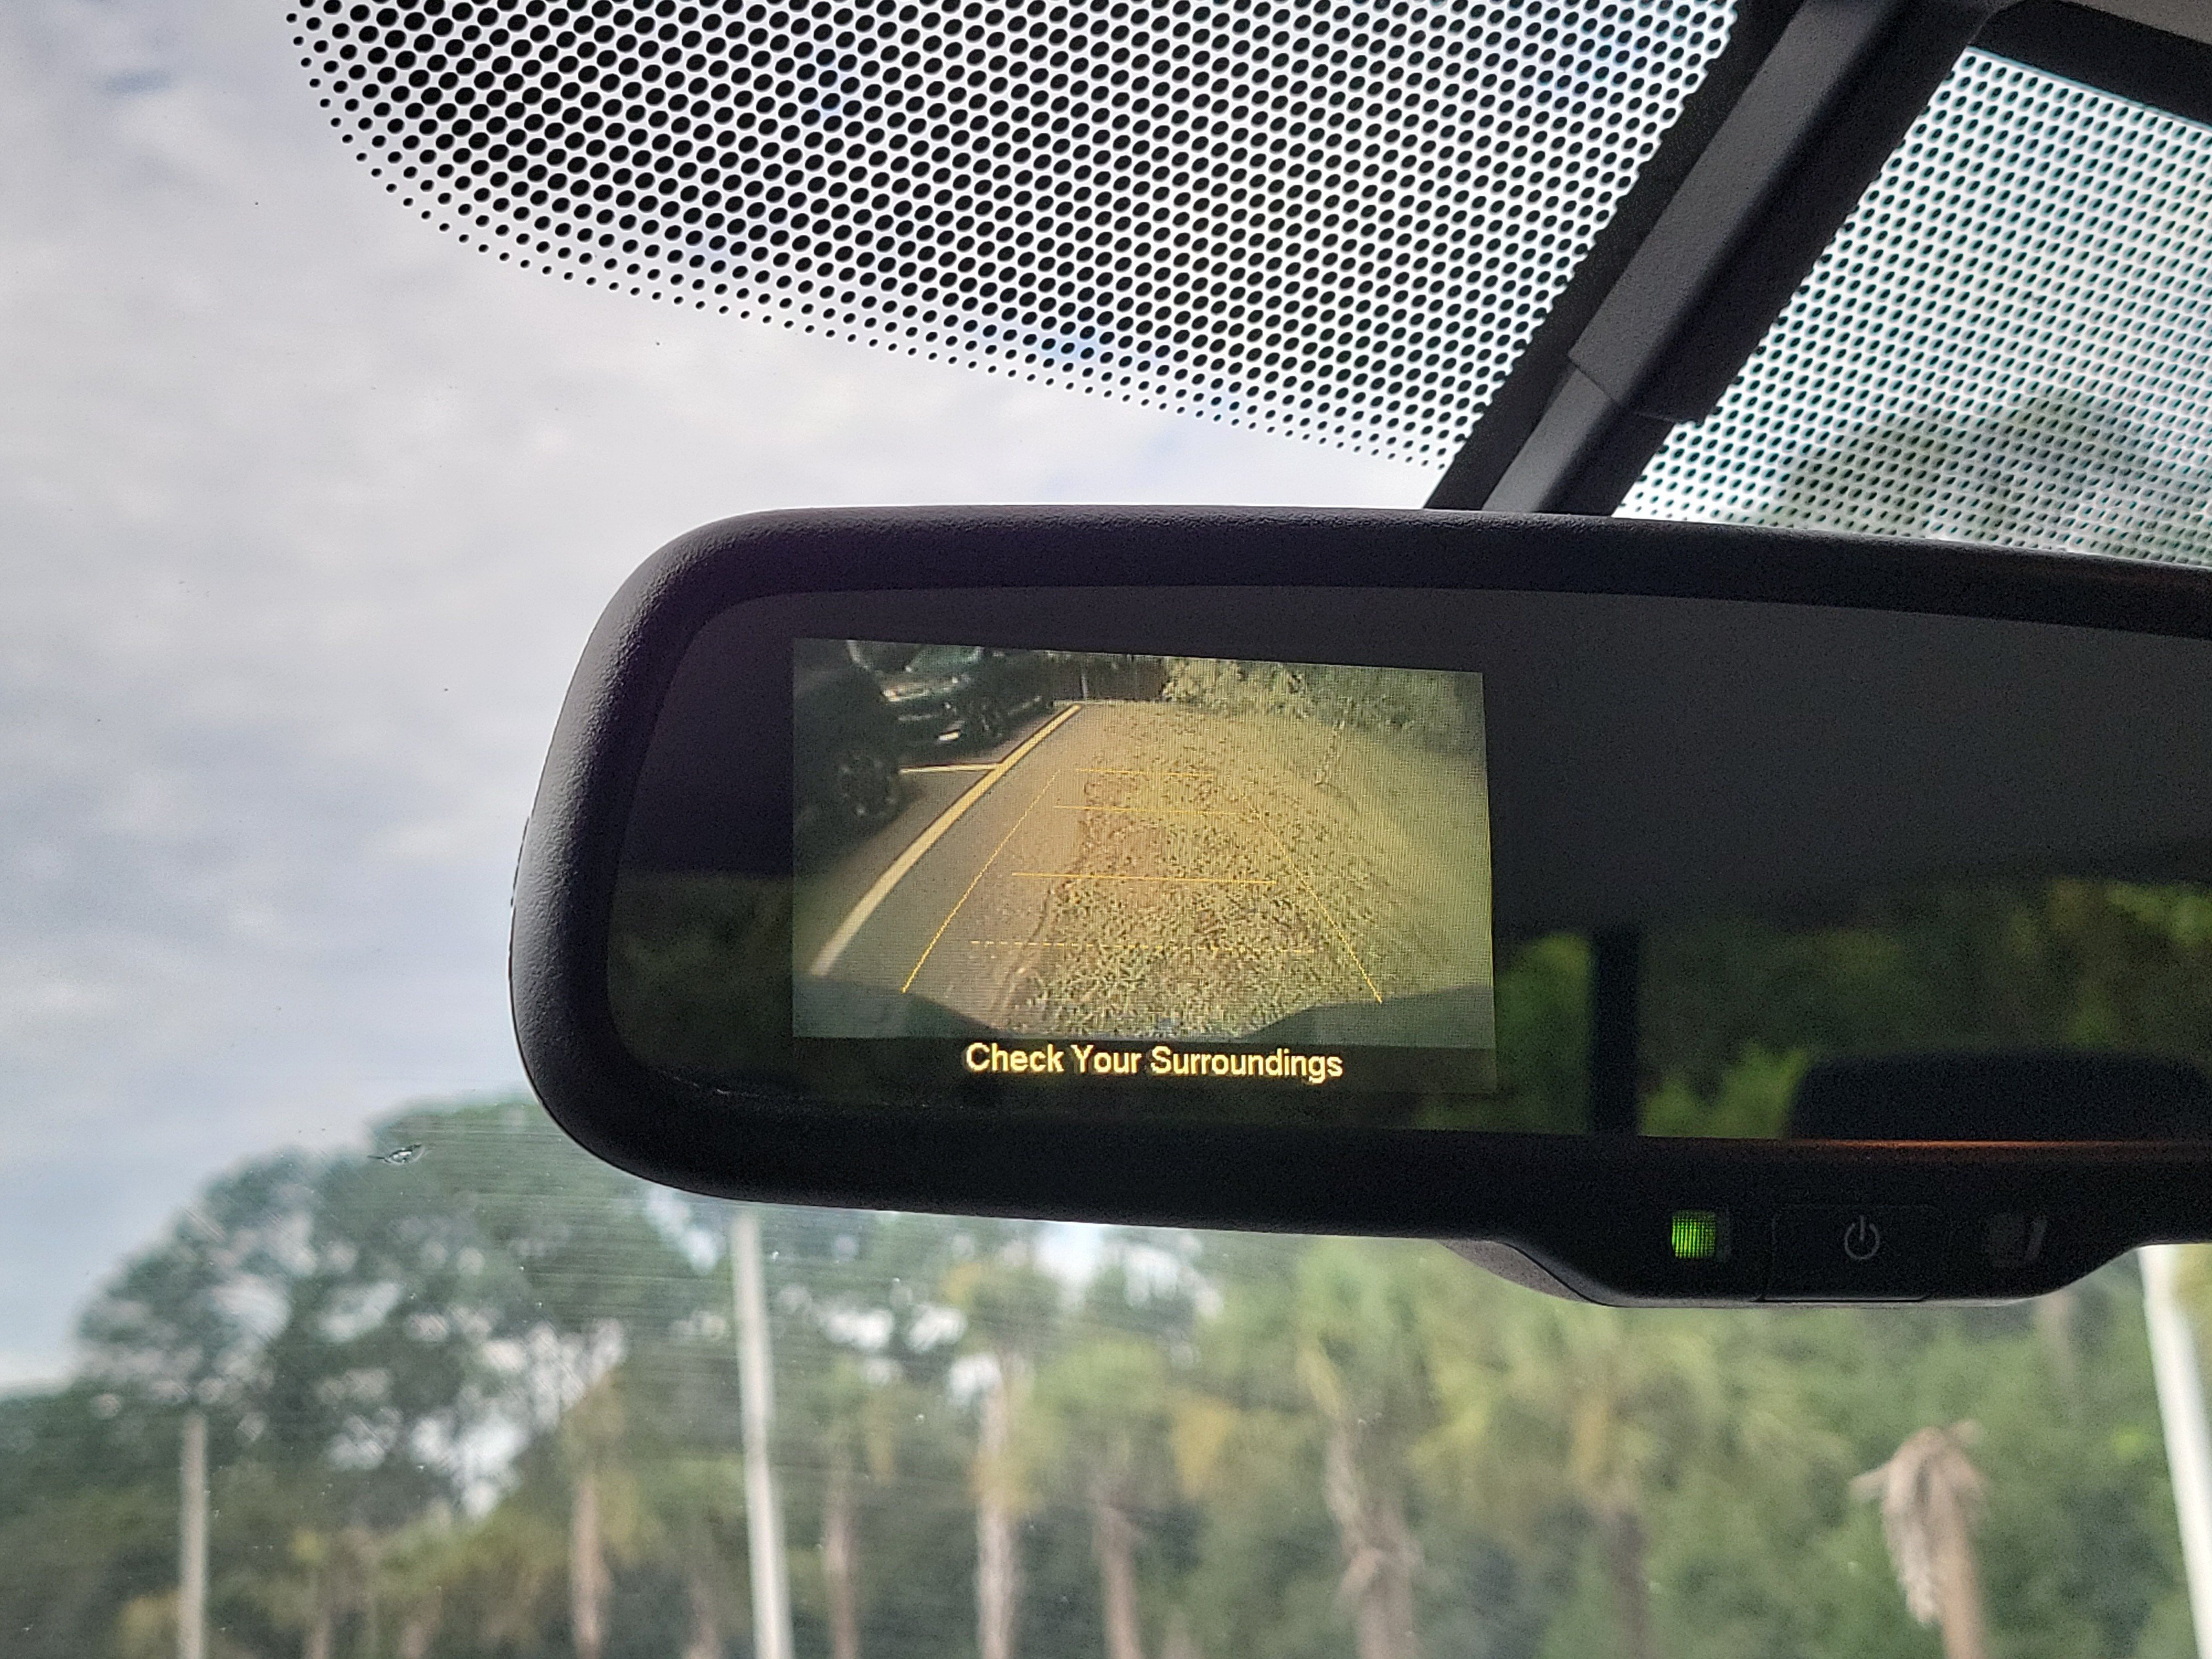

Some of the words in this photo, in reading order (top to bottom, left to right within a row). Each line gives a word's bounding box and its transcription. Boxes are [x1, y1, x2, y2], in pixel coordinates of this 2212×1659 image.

[966, 1042, 1064, 1073] Check
[1070, 1045, 1142, 1074] Your
[1151, 1046, 1343, 1084] Surroundings
